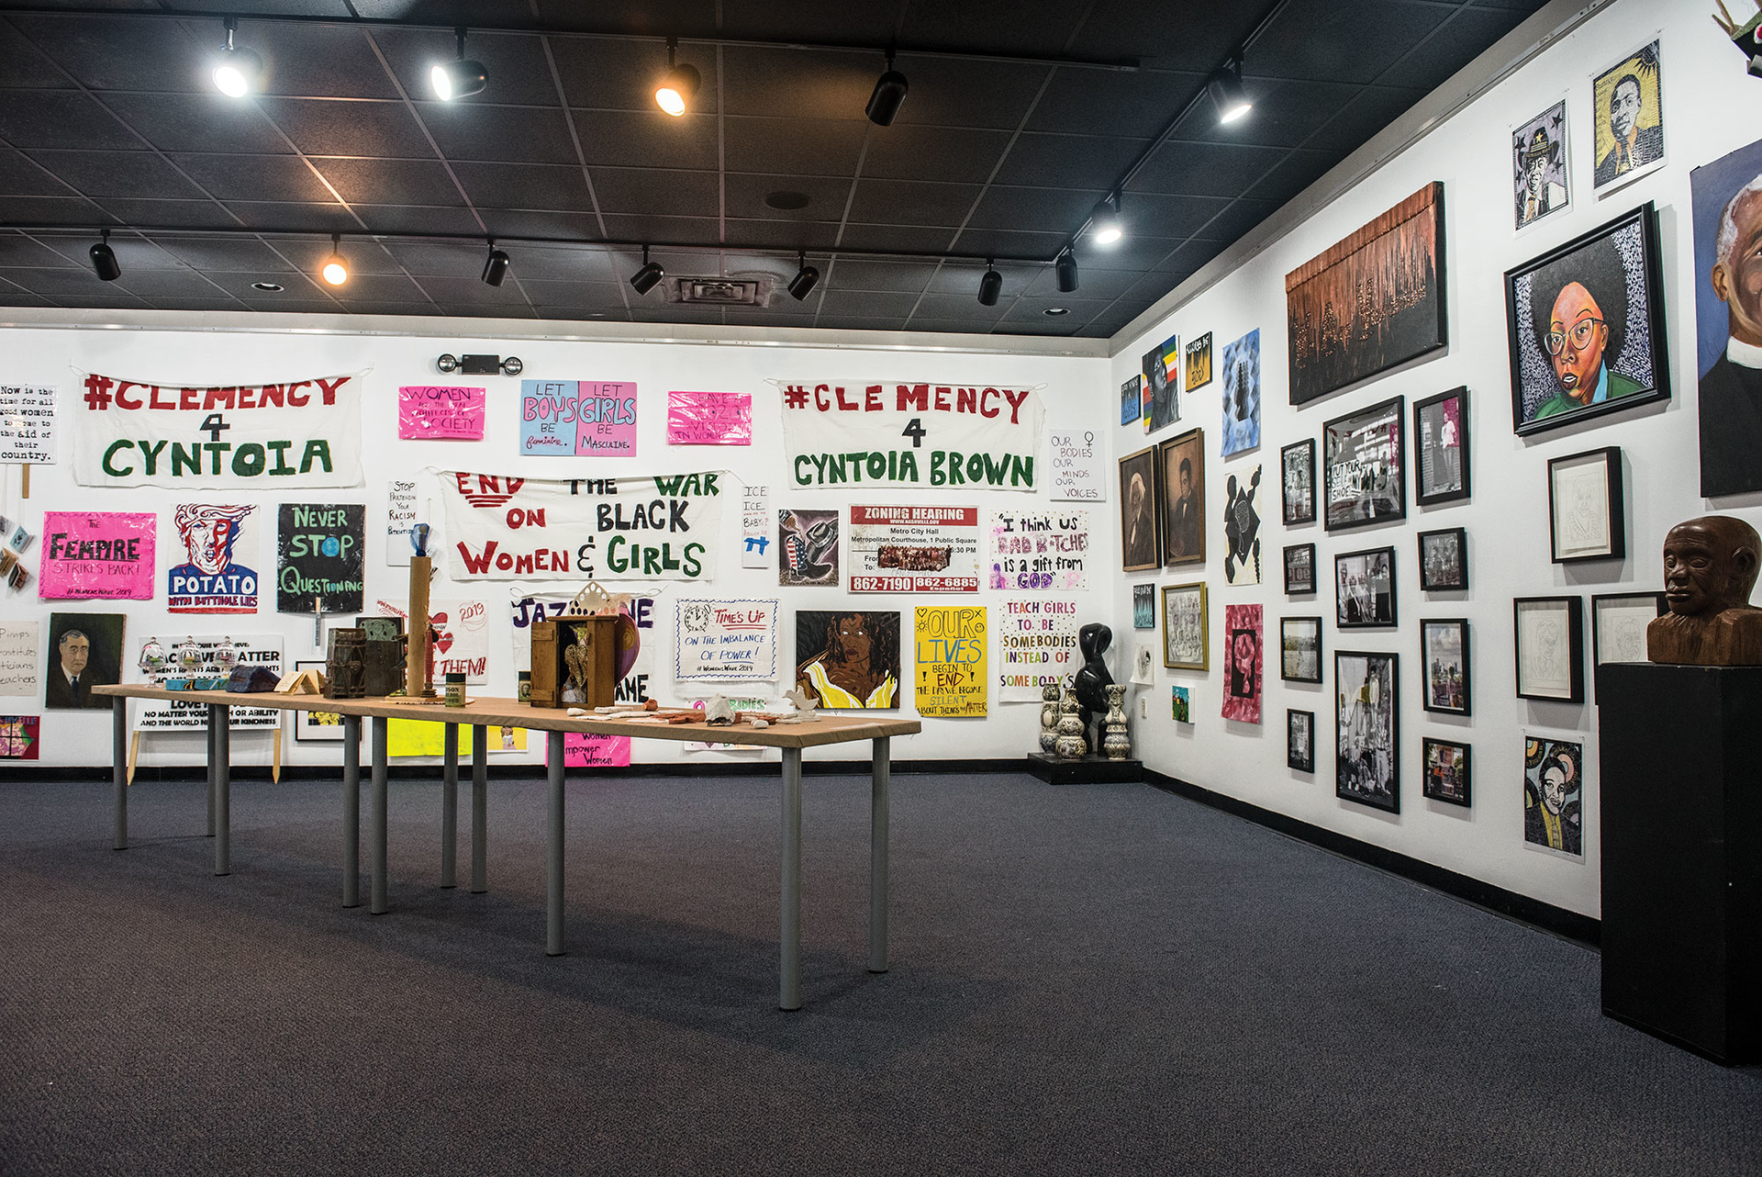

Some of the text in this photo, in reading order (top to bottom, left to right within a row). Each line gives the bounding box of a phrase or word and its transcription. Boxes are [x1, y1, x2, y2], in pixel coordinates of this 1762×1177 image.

[1, 386, 20, 395] Now
[84, 374, 351, 410] #CLEMENCY
[405, 387, 470, 401] WOMEN
[536, 383, 565, 396] LET
[594, 384, 622, 397] LET
[21, 409, 54, 417] women
[524, 396, 577, 423] BOYS
[579, 397, 637, 425] GIRLS
[200, 414, 230, 441] 4
[541, 423, 556, 433] BE
[597, 424, 613, 434] BE
[902, 418, 926, 447] 4
[14, 441, 38, 449] their
[1051, 435, 1072, 447] OUR
[1, 451, 51, 461] country.
[102, 439, 333, 477] CYNTOIA
[1060, 447, 1093, 458] BODIES
[795, 451, 1034, 487] CYNTOIA BROWN
[1053, 458, 1074, 468] OUR
[1062, 470, 1090, 478] MINDS
[394, 481, 416, 491] STOP
[456, 472, 719, 497] END THE WAR
[1055, 477, 1076, 486] OUR
[744, 486, 767, 497] ICE
[1063, 488, 1098, 498] VOICES
[743, 501, 765, 511] ICE
[294, 506, 348, 528] NEVER
[388, 510, 416, 520] RACISM
[506, 508, 546, 530] ON
[597, 499, 690, 532] BLACK
[865, 507, 964, 520] ZONING HEARING
[1020, 517, 1052, 532] think
[289, 534, 354, 559] STOP
[578, 536, 596, 578] &
[607, 535, 706, 577] GIRLS
[108, 563, 140, 576] BACK!
[1004, 555, 1083, 573] is a gift from
[173, 576, 256, 595] POTATO
[853, 577, 977, 591] 862-7190 862-6885
[195, 596, 239, 606] BUTTHOLE
[459, 602, 485, 622] 2019
[1007, 602, 1076, 614] TEACH GIRLS
[928, 609, 976, 638] OUR
[1017, 619, 1054, 631] TO BE
[685, 637, 699, 646] ON
[702, 636, 717, 645] THE
[1004, 635, 1076, 648] SOMEBODIES
[237, 651, 280, 661] ATTER
[701, 650, 717, 660] OF
[917, 639, 982, 663] LIVES
[1006, 652, 1070, 663] INSTEAD OF
[932, 663, 973, 673] BEGIN TO
[937, 672, 965, 687] END
[615, 674, 649, 703] AME
[171, 700, 201, 709] LOVE
[930, 695, 967, 706] SILENT
[140, 719, 157, 727] AND
[565, 745, 601, 757] mpower
[583, 752, 613, 765] Women
